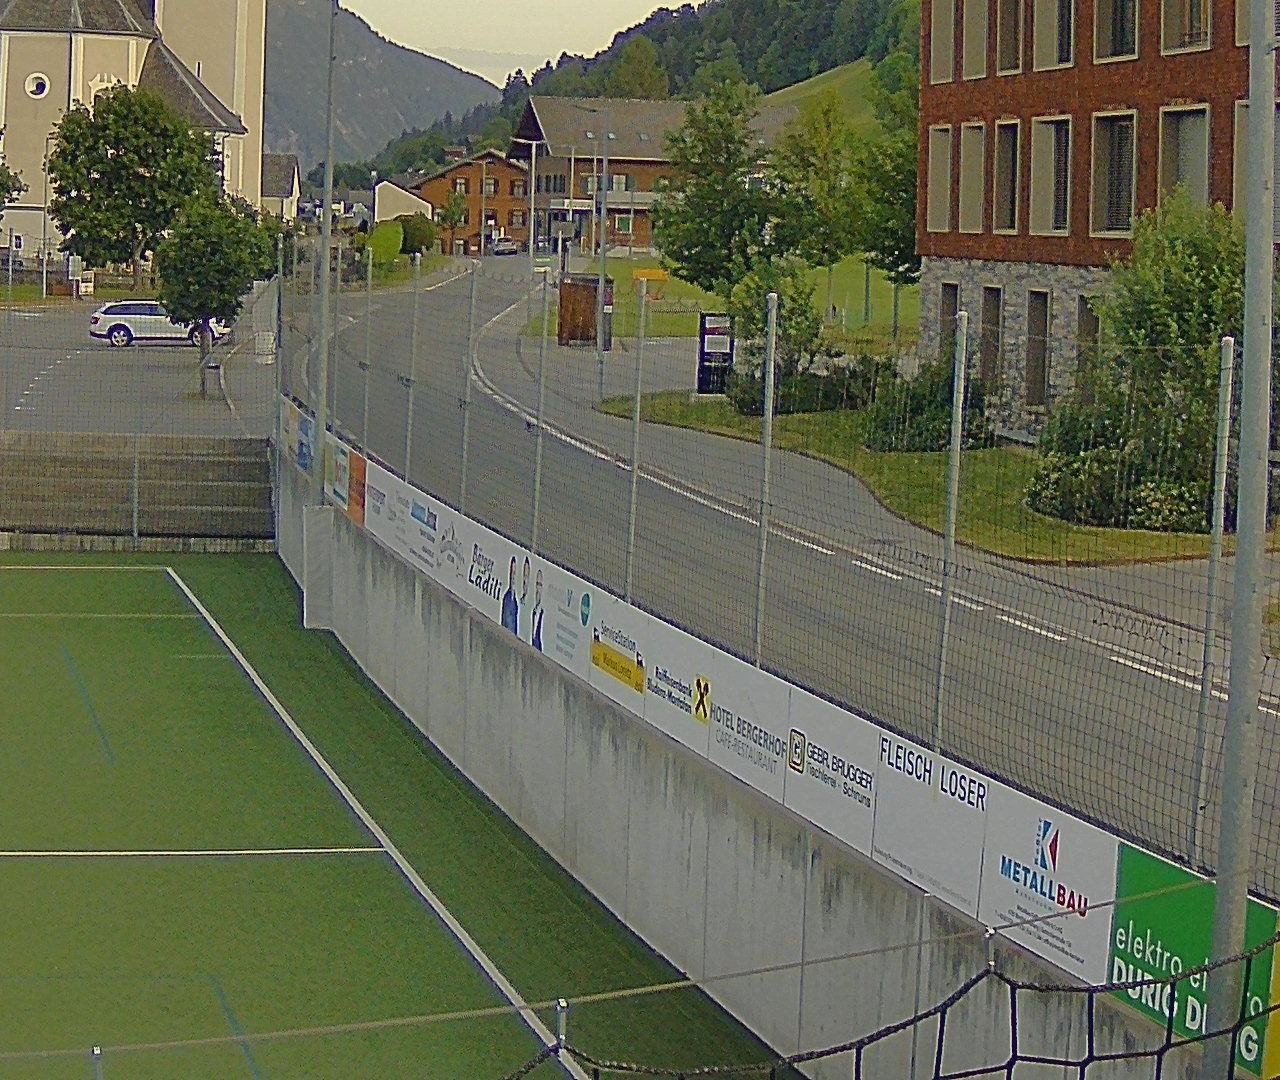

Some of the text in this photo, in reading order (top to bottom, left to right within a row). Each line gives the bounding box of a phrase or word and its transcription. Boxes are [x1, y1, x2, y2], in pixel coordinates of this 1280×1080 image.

[710, 703, 787, 759] HOTEL BERGERHOF
[831, 756, 873, 791] BRUGGER
[880, 737, 987, 811] FLEISCH LOSER
[1000, 855, 1088, 918] METALLBAU
[1116, 920, 1182, 977] elektro
